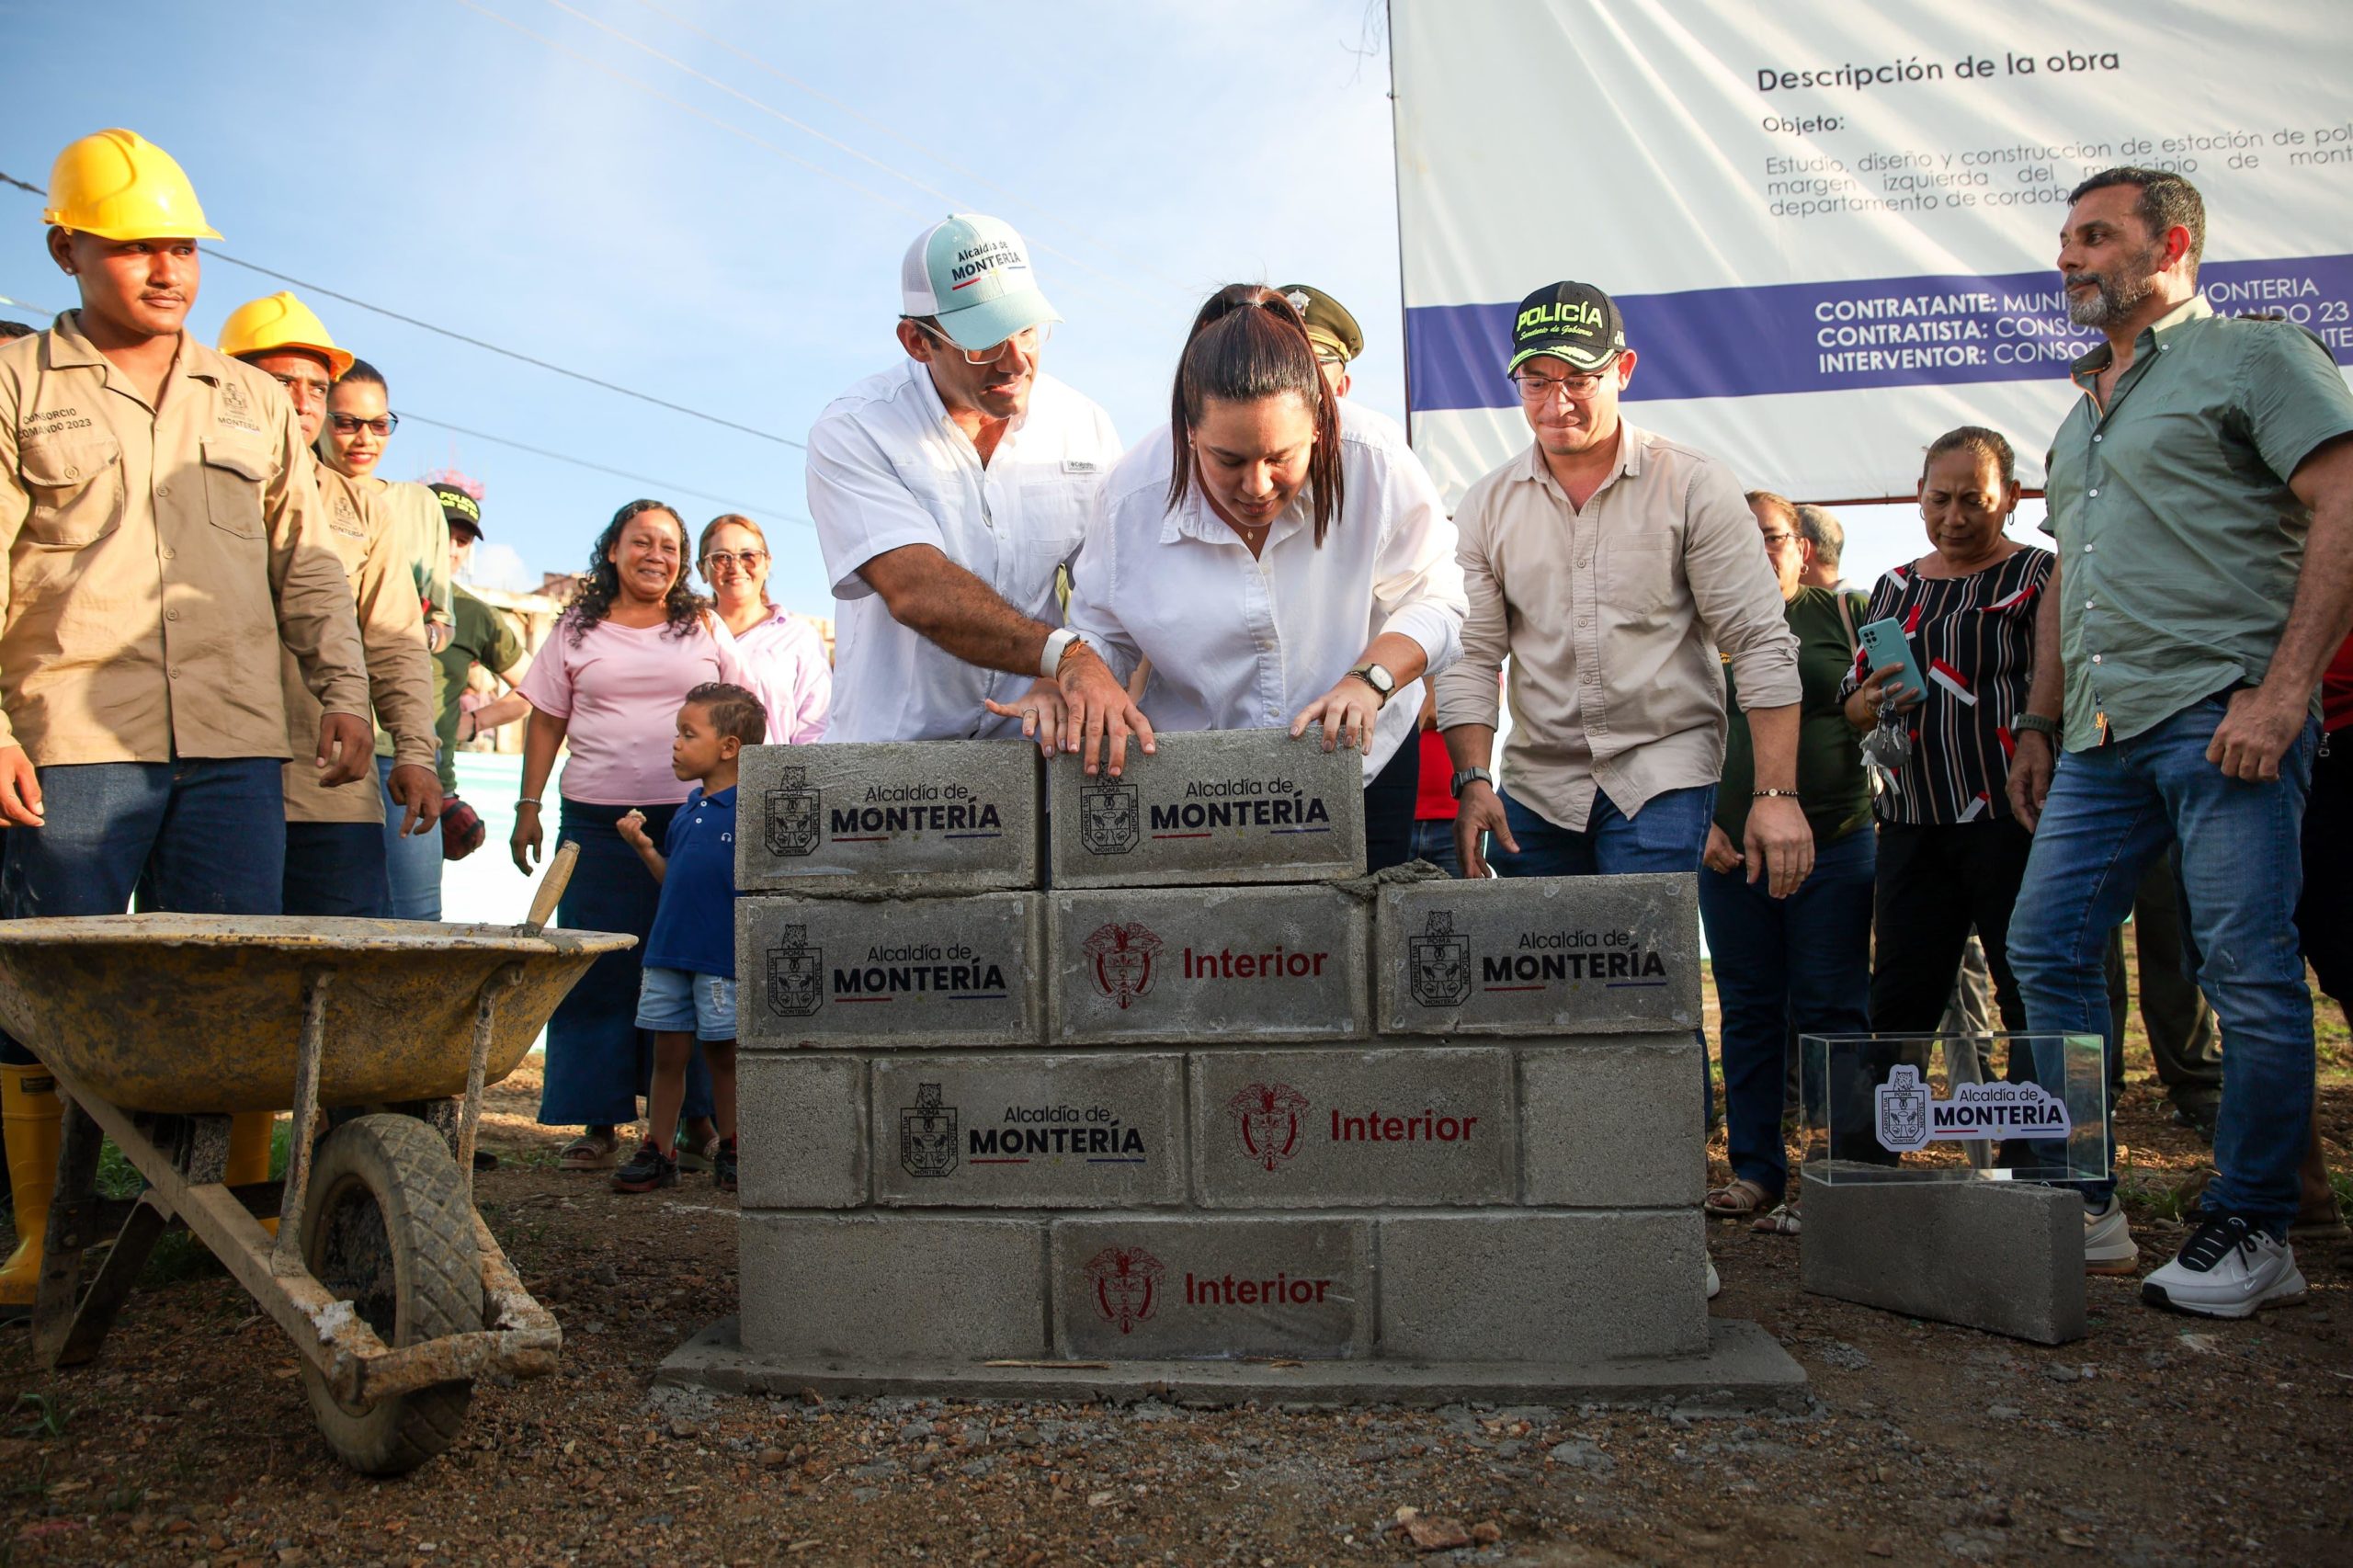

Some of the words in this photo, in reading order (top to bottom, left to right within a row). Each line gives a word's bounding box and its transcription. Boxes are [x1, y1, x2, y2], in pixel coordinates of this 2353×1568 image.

[1757, 56, 1943, 91] Descripción
[1955, 55, 1995, 79] de
[2007, 52, 2036, 75] la
[2046, 50, 2120, 72] obra
[1763, 115, 1845, 135] Objeto:
[1767, 156, 1849, 175] Estudio,
[1858, 152, 1932, 172] diseño
[1940, 153, 1952, 170] y
[1961, 142, 2111, 165] construccion
[2121, 137, 2152, 155] de
[2162, 131, 2263, 153] estación
[2272, 129, 2305, 145] de
[1768, 176, 1857, 197] margen
[1883, 172, 1988, 193] izquierda
[2018, 165, 2053, 183] del
[2228, 153, 2259, 170] de
[1770, 193, 1938, 218] departamento
[1946, 191, 1976, 208] de
[1984, 186, 2069, 206] cordob
[1517, 301, 1603, 332] POLICÍA
[1815, 293, 1997, 322] CONTRATANTE:
[1817, 320, 1988, 347] CONTRATISTA:
[2318, 301, 2349, 323] 23
[1819, 346, 1987, 373] INTERVENTOR:
[18, 421, 64, 440] COMANDO
[67, 418, 93, 431] 2023
[22, 407, 77, 426] CONSORCIO
[865, 783, 942, 802] Alcaldía
[944, 783, 969, 800] de
[1186, 778, 1262, 798] Alcaldía
[1268, 777, 1294, 794] de
[831, 795, 1002, 833] MONTERÍA
[1151, 790, 1330, 829] MONTERÍA
[867, 945, 941, 962] Alcaldía
[947, 943, 972, 960] de
[1518, 930, 1597, 949] Alcaldía
[1603, 930, 1630, 947] de
[834, 957, 1006, 993] MONTERÍA
[1184, 946, 1328, 979] Interior
[1483, 942, 1666, 982] MONTERÍA
[1960, 1088, 2016, 1102] Alcaldía
[2019, 1088, 2039, 1101] de
[1004, 1106, 1079, 1123] Alcaldía
[1086, 1106, 1110, 1122] de
[1332, 1109, 1477, 1142] Interior
[1934, 1098, 2063, 1126] MONTERÍA
[969, 1119, 1146, 1154] MONTERÍA
[1186, 1272, 1331, 1304] Interior
